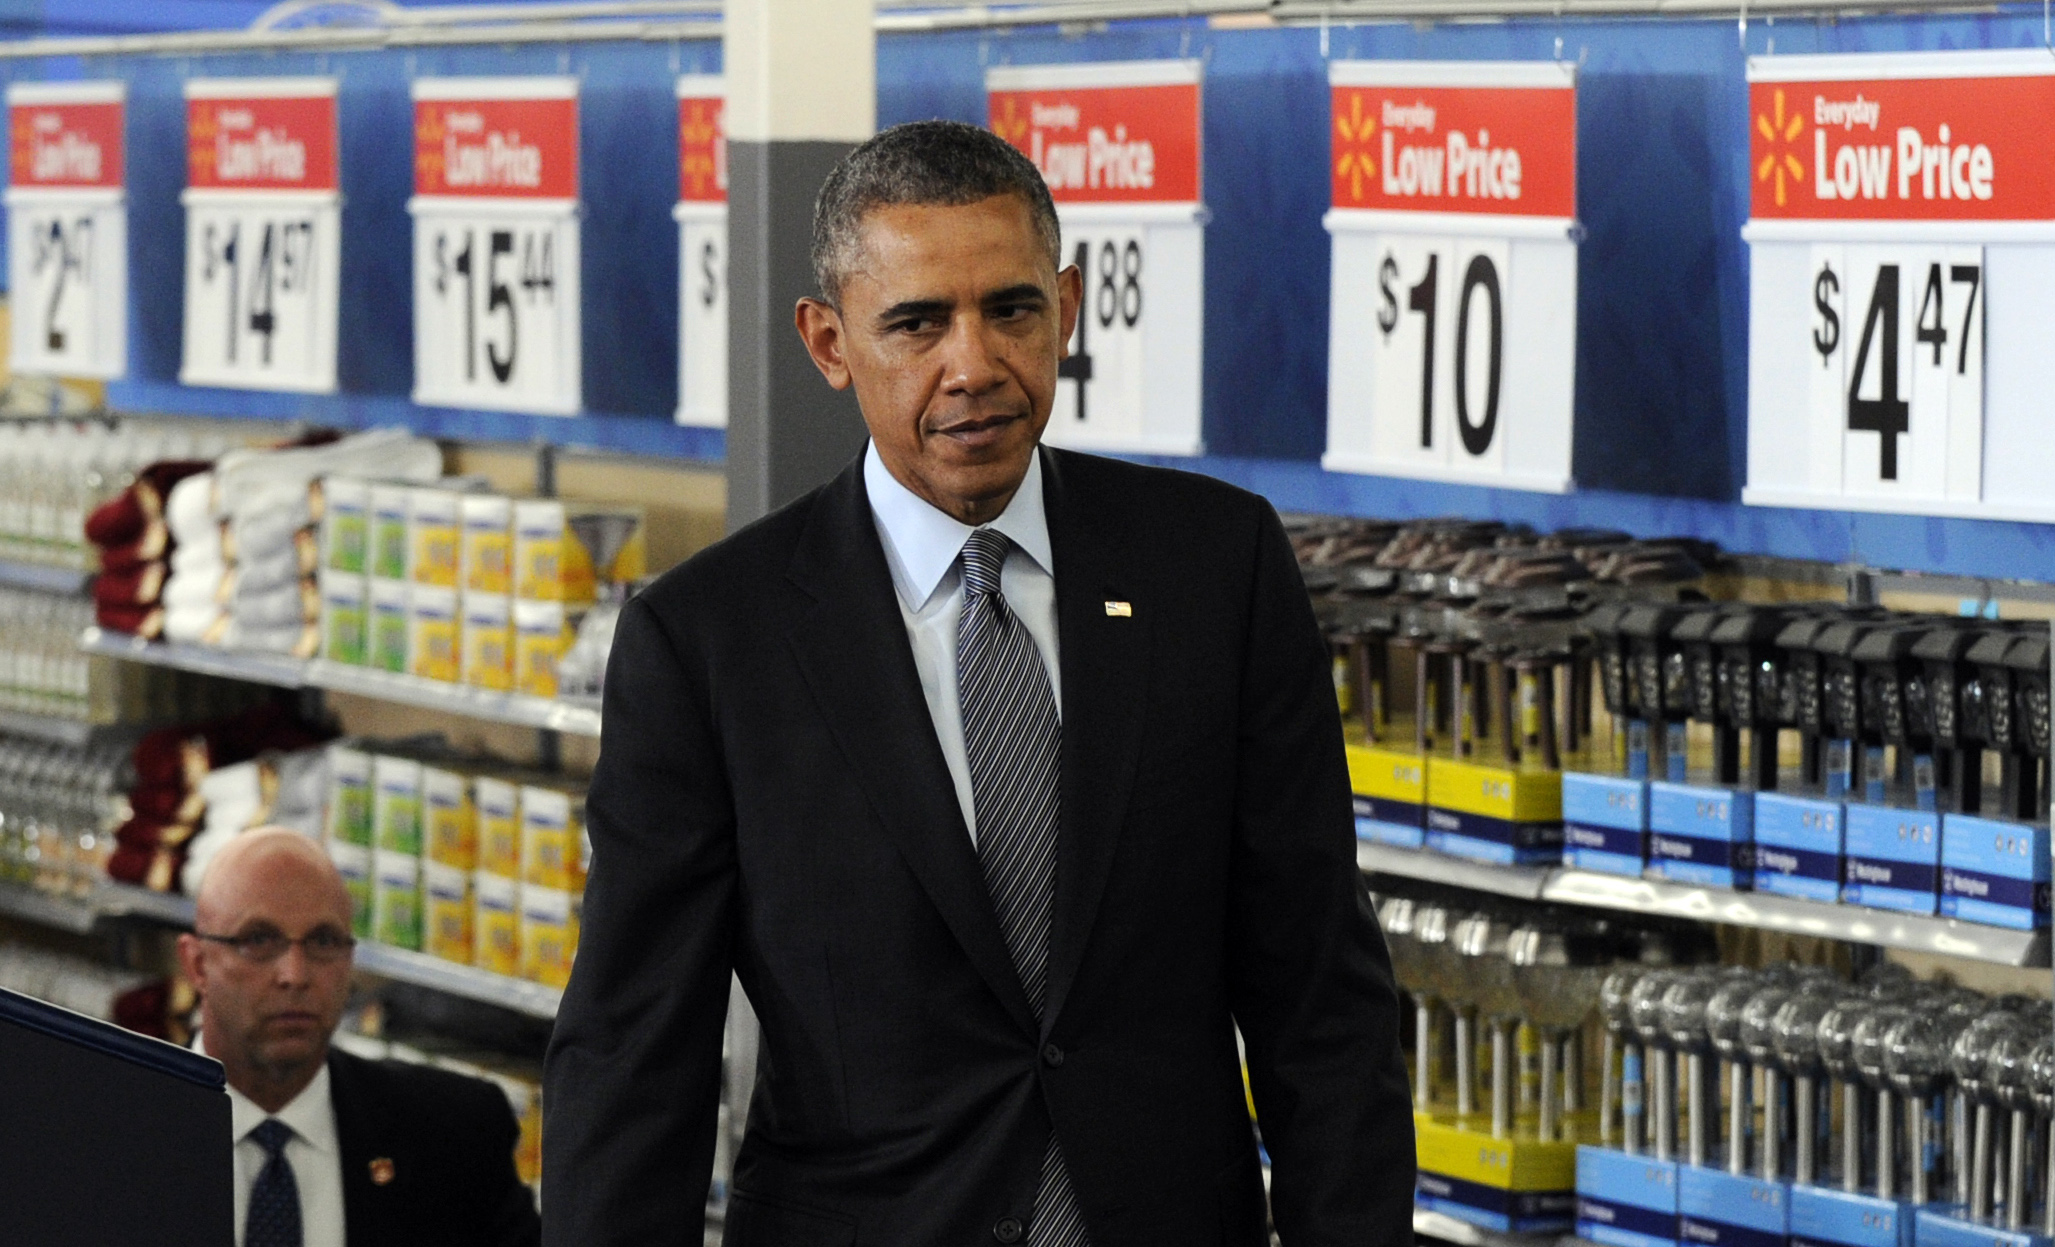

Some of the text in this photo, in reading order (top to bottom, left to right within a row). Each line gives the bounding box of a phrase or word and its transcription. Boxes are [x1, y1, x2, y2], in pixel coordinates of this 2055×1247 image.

[1814, 95, 1880, 131] Everyday
[1088, 123, 1155, 190] Price
[1382, 128, 1521, 200] Low Price
[1814, 122, 1994, 201] Low Price
[1377, 247, 1502, 456] $10
